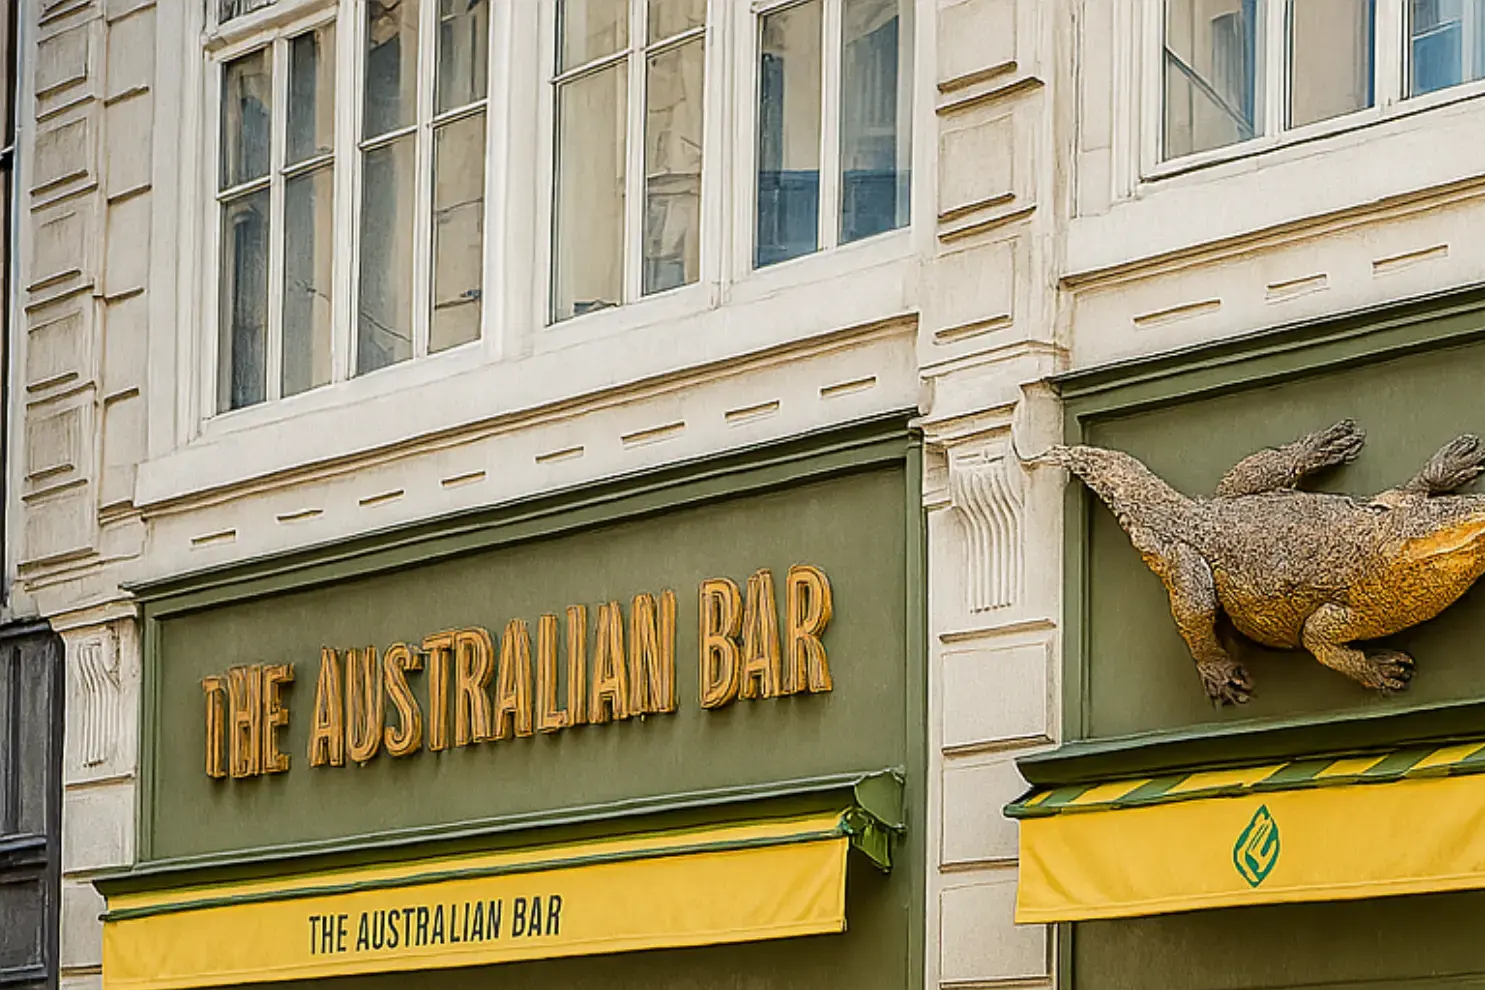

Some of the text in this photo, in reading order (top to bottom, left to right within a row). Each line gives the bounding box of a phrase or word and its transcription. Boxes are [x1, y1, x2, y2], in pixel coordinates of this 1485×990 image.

[202, 564, 835, 779] THE AUSTRALIAN BAR
[308, 894, 562, 955] THE AUSTRALIAN BAR
